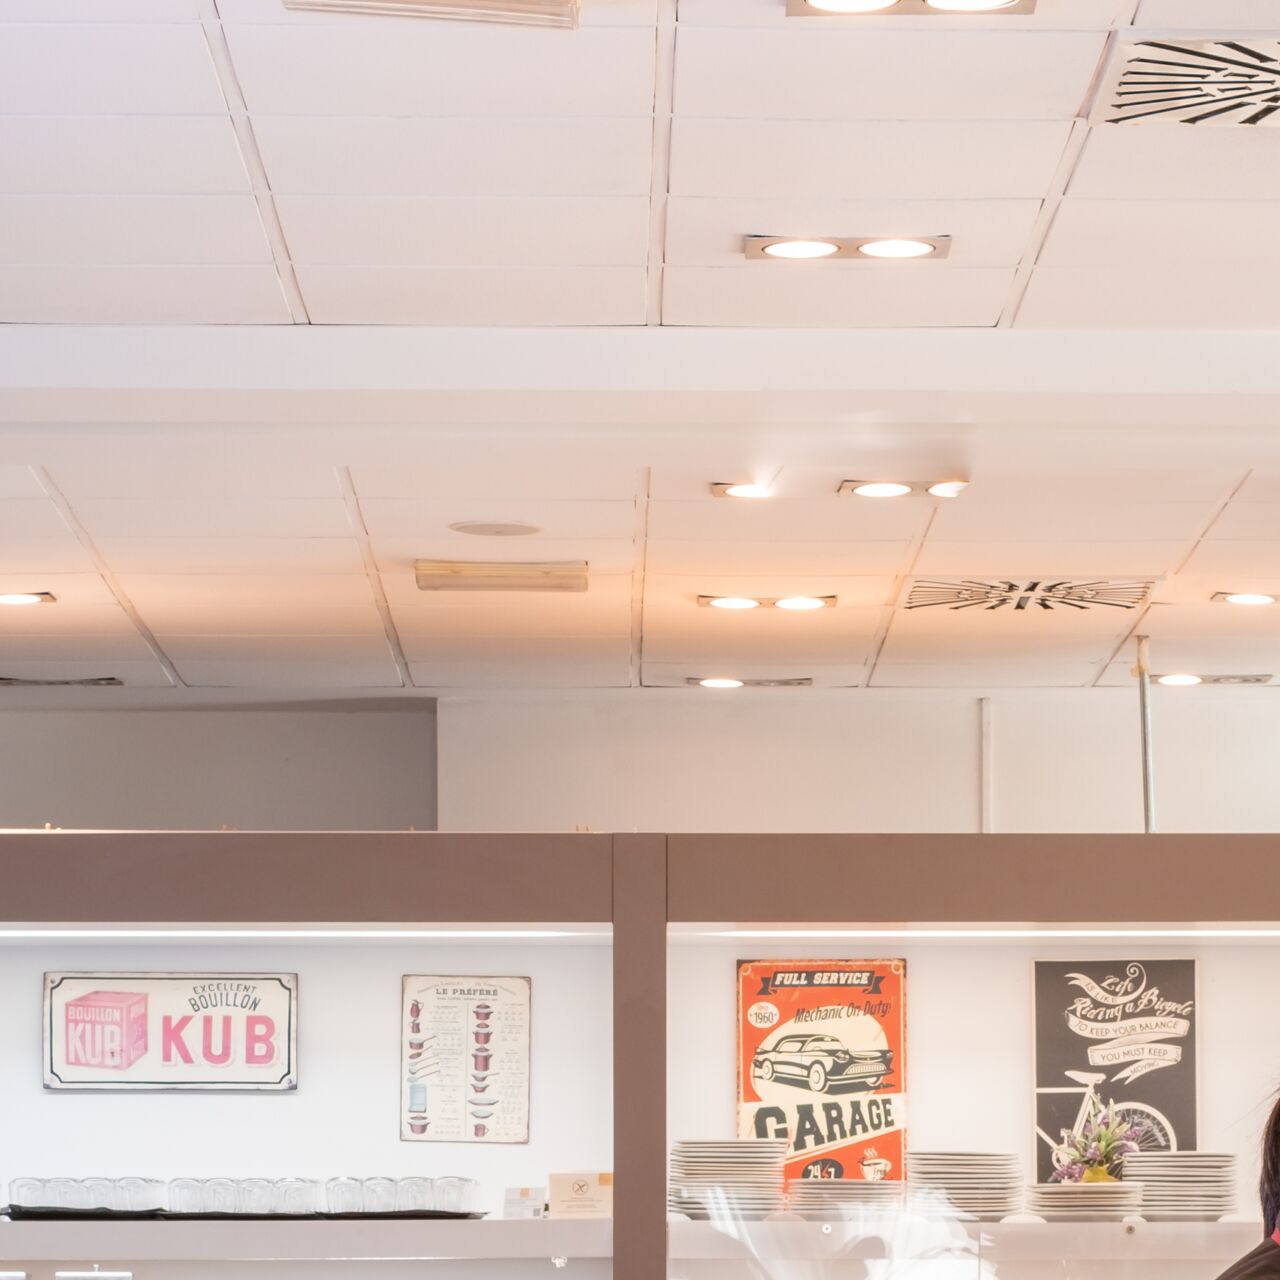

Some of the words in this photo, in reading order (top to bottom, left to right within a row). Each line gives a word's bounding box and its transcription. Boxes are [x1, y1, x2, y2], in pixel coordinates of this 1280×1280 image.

[775, 972, 808, 985] FULL
[813, 972, 871, 985] SERVICE
[1100, 975, 1134, 995] Life
[193, 983, 258, 995] EXCELLENT
[1094, 991, 1116, 1003] LIKE
[188, 993, 261, 1012] BOUILLON
[1067, 997, 1123, 1022] Riding
[1125, 1002, 1135, 1013] a
[1135, 986, 1193, 1019] Bicycle
[68, 1007, 121, 1022] BOUILLON
[754, 1012, 774, 1024] 1960
[794, 1003, 843, 1023] Mechanic
[846, 1002, 862, 1017] On
[1074, 1020, 1088, 1031] TO
[1090, 1026, 1111, 1037] KEEP
[1112, 1024, 1138, 1037] YOUR
[1139, 1020, 1179, 1032] BALANCE
[67, 1022, 121, 1065] KUB
[162, 1015, 277, 1065] KUB
[1100, 1051, 1120, 1062] YOU
[1123, 1047, 1145, 1057] MUST
[1148, 1047, 1168, 1056] KEEP
[1130, 1061, 1160, 1075] MOVING
[754, 1098, 895, 1152] GARAGE
